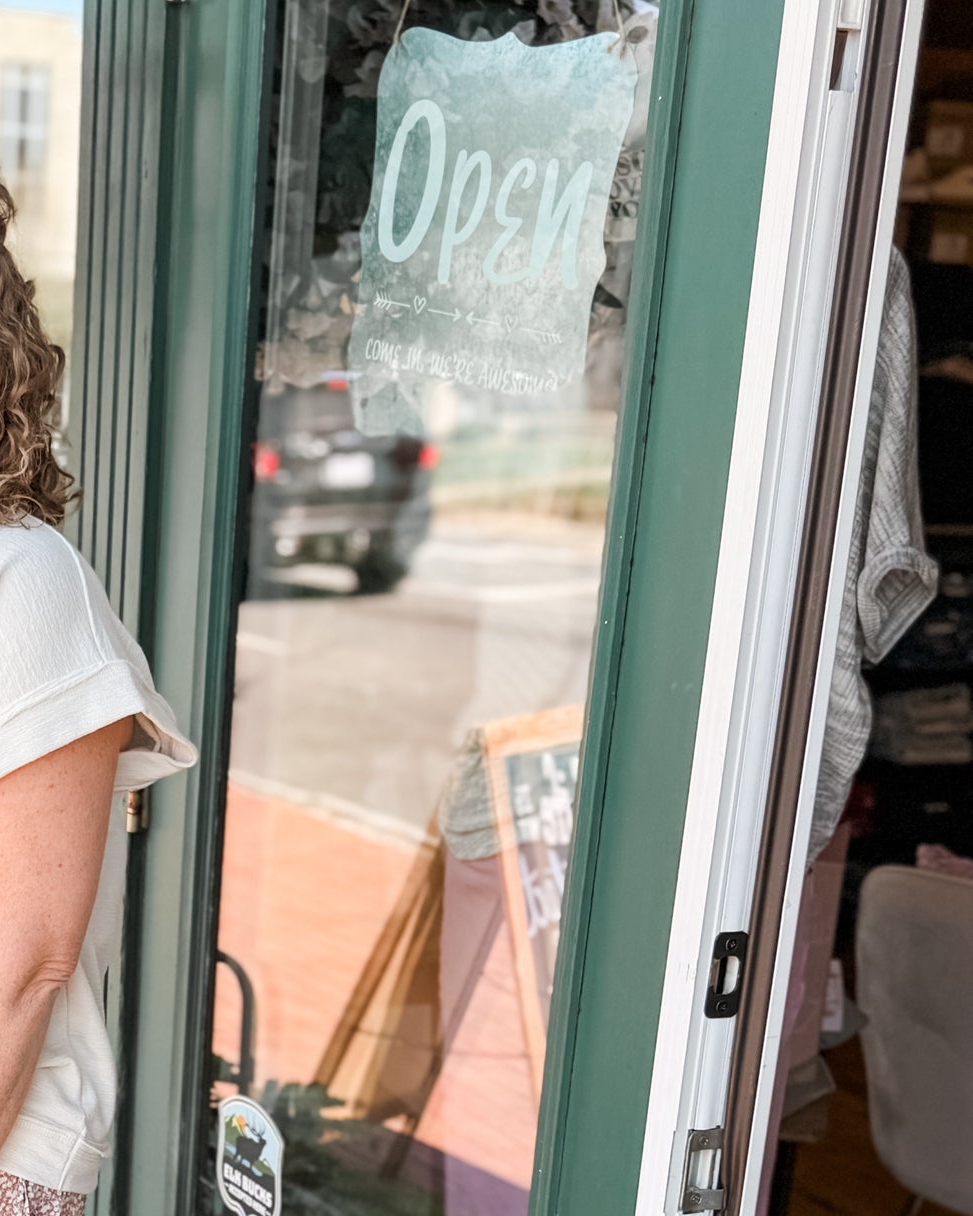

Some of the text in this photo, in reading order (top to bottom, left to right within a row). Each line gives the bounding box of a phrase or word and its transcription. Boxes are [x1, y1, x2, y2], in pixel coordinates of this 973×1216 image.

[365, 338, 402, 368] COME
[223, 1162, 273, 1208] ELK BUCKS
